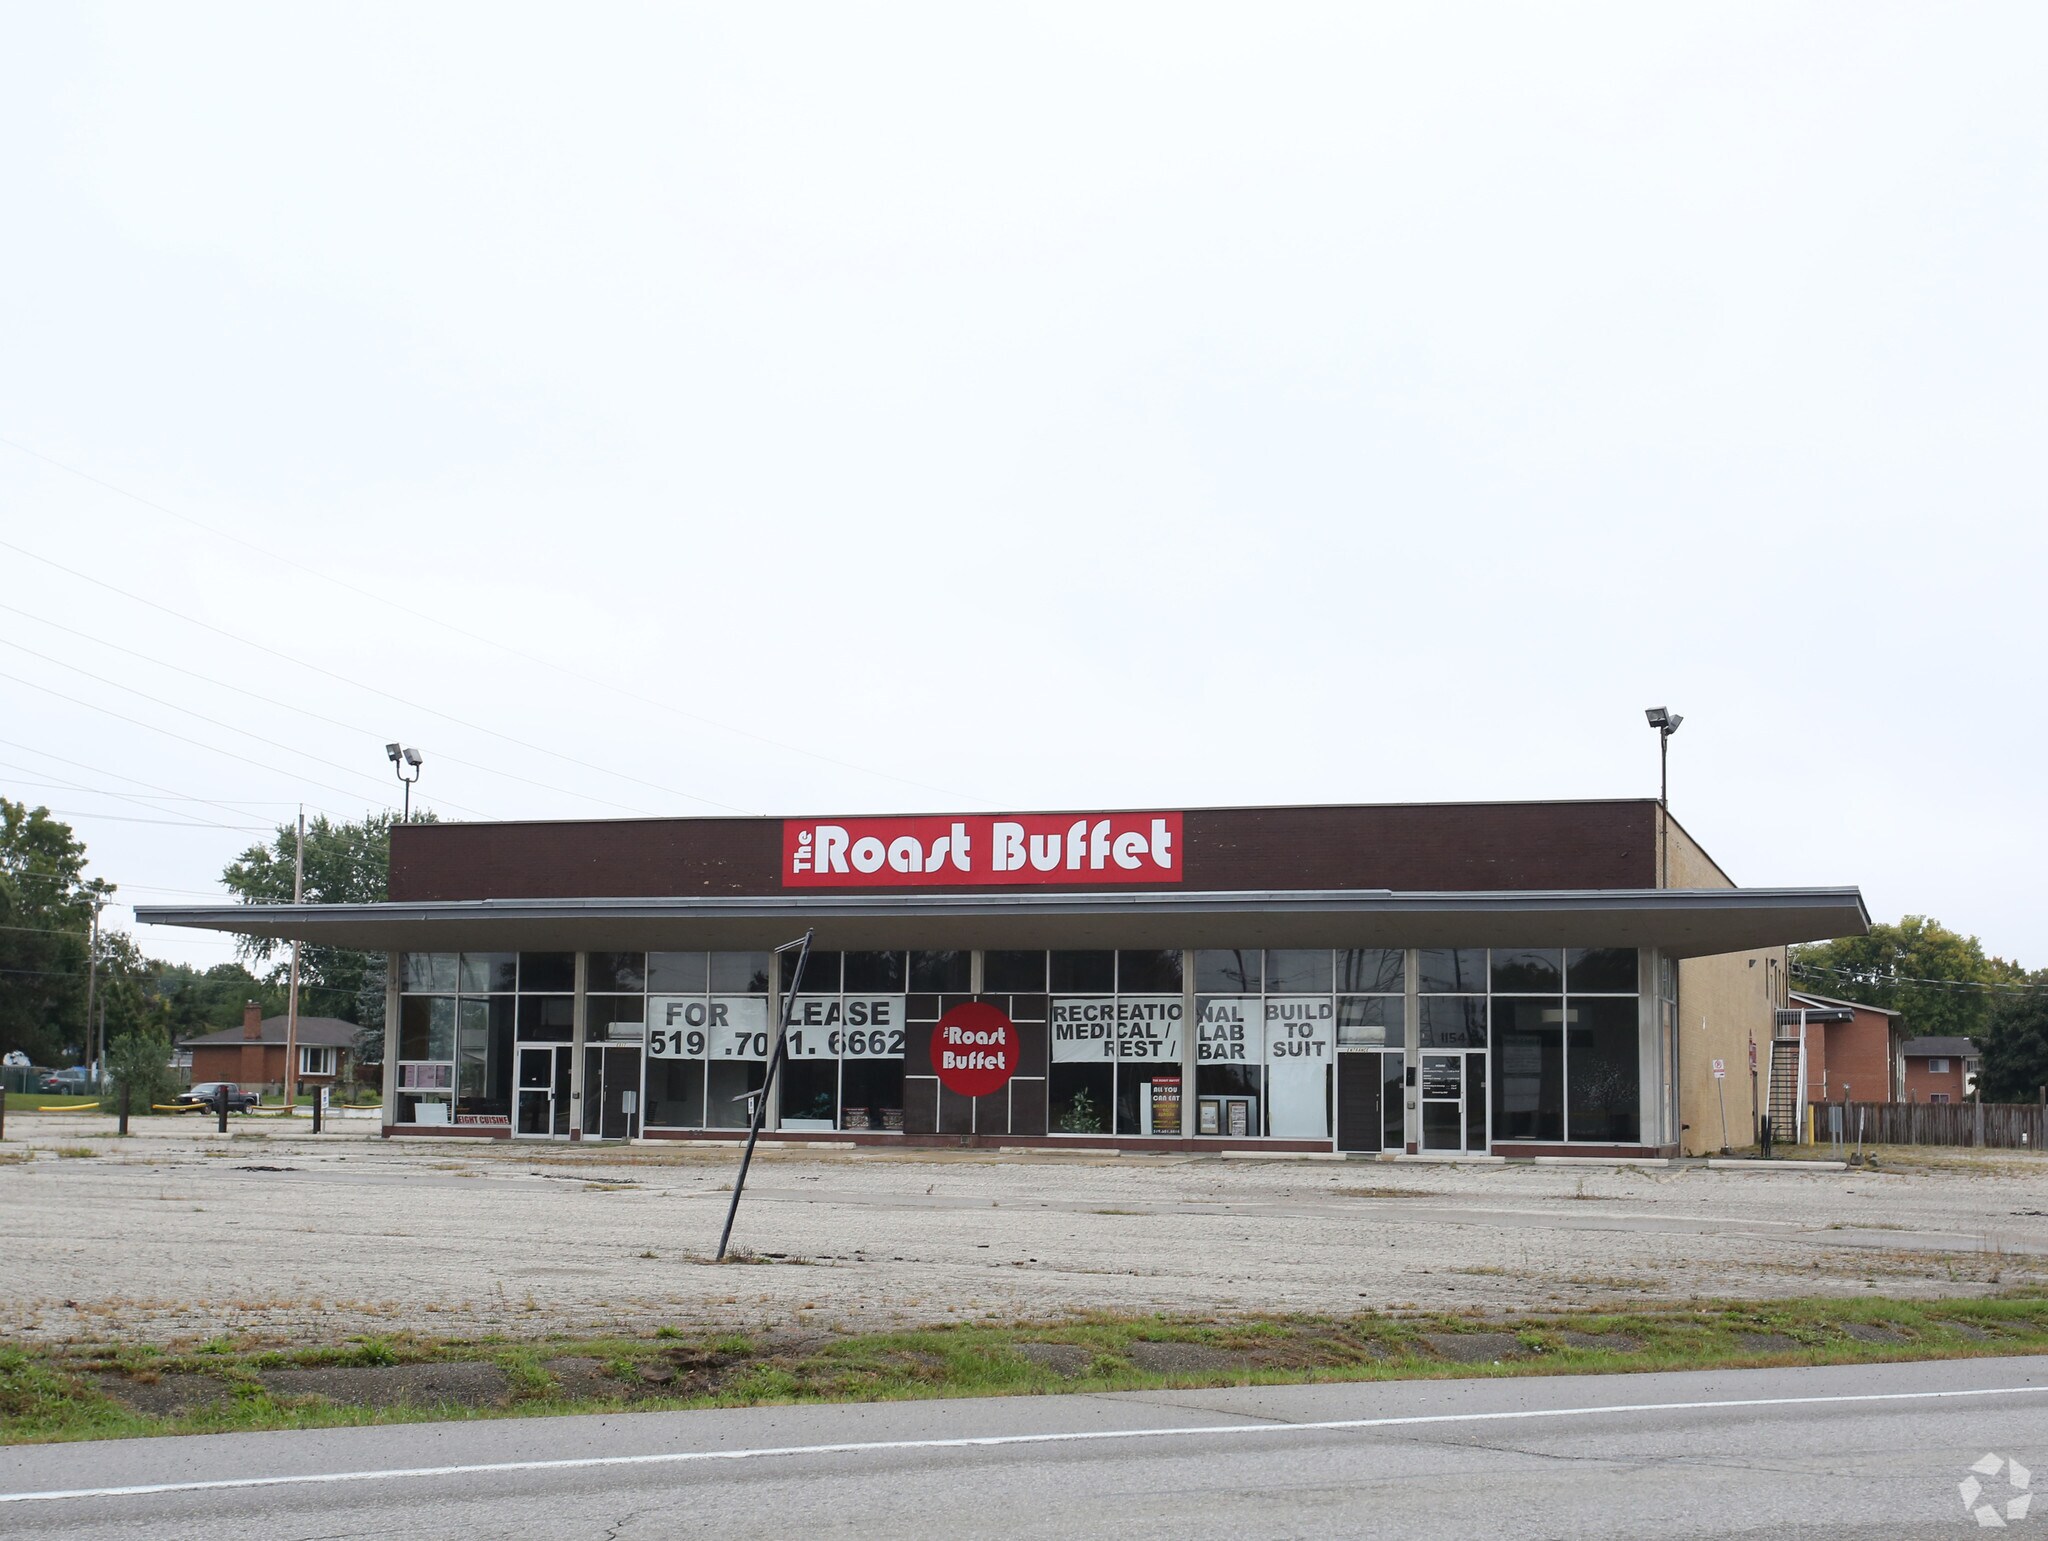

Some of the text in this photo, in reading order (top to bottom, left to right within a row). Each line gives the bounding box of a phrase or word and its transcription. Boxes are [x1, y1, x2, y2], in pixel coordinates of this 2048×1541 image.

[793, 818, 1172, 874] The Roast Buffet
[665, 1002, 729, 1027] FOR
[1053, 1003, 1183, 1022] RECREATIO
[1265, 1003, 1333, 1021] BUILD
[948, 1026, 1006, 1045] Roast
[1056, 1022, 1158, 1040] MEDICAL
[1199, 1024, 1245, 1042] LAB
[1283, 1022, 1314, 1039] TO
[1104, 1040, 1163, 1057] REST
[1198, 1043, 1245, 1060] BAR
[1273, 1041, 1326, 1057] SUIT
[942, 1051, 1006, 1070] Buffet
[480, 1116, 508, 1124] CUISINE
